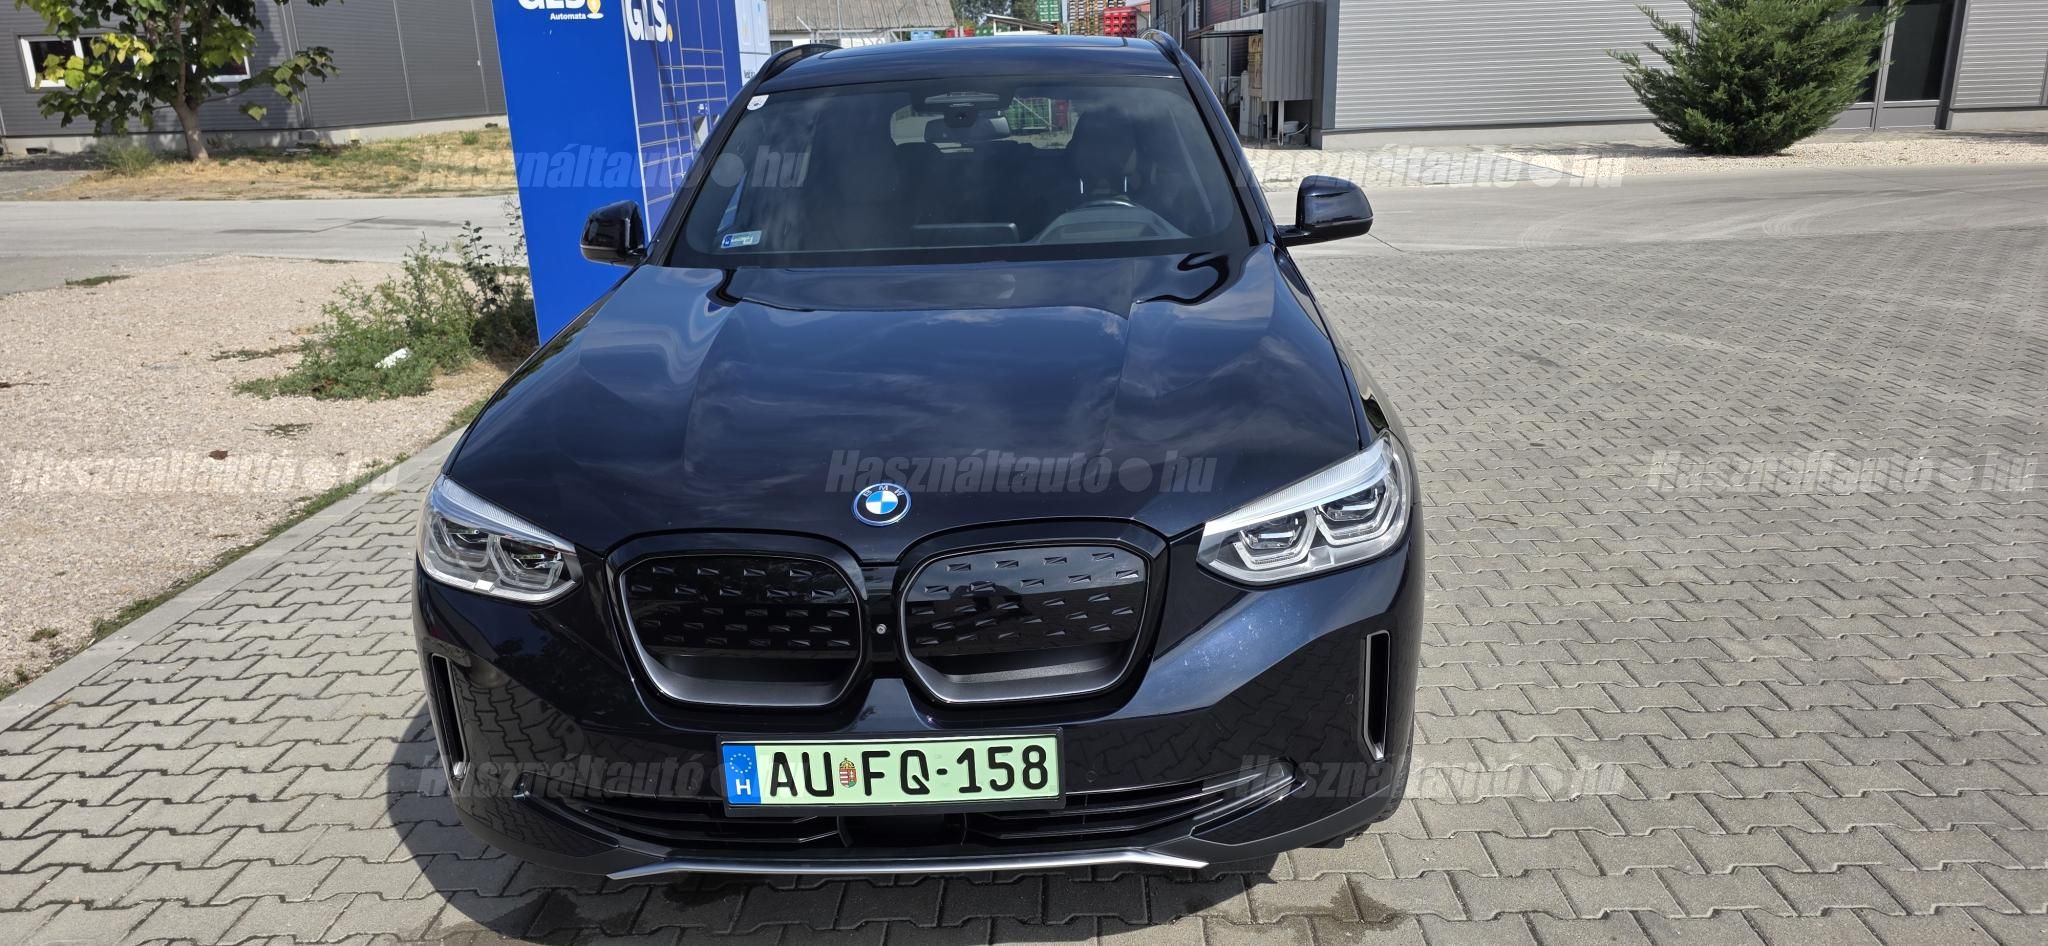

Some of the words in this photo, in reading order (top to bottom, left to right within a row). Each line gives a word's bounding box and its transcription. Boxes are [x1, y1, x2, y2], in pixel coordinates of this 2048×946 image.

[863, 485, 905, 497] BMW
[770, 752, 834, 796] AU
[736, 779, 751, 796] H
